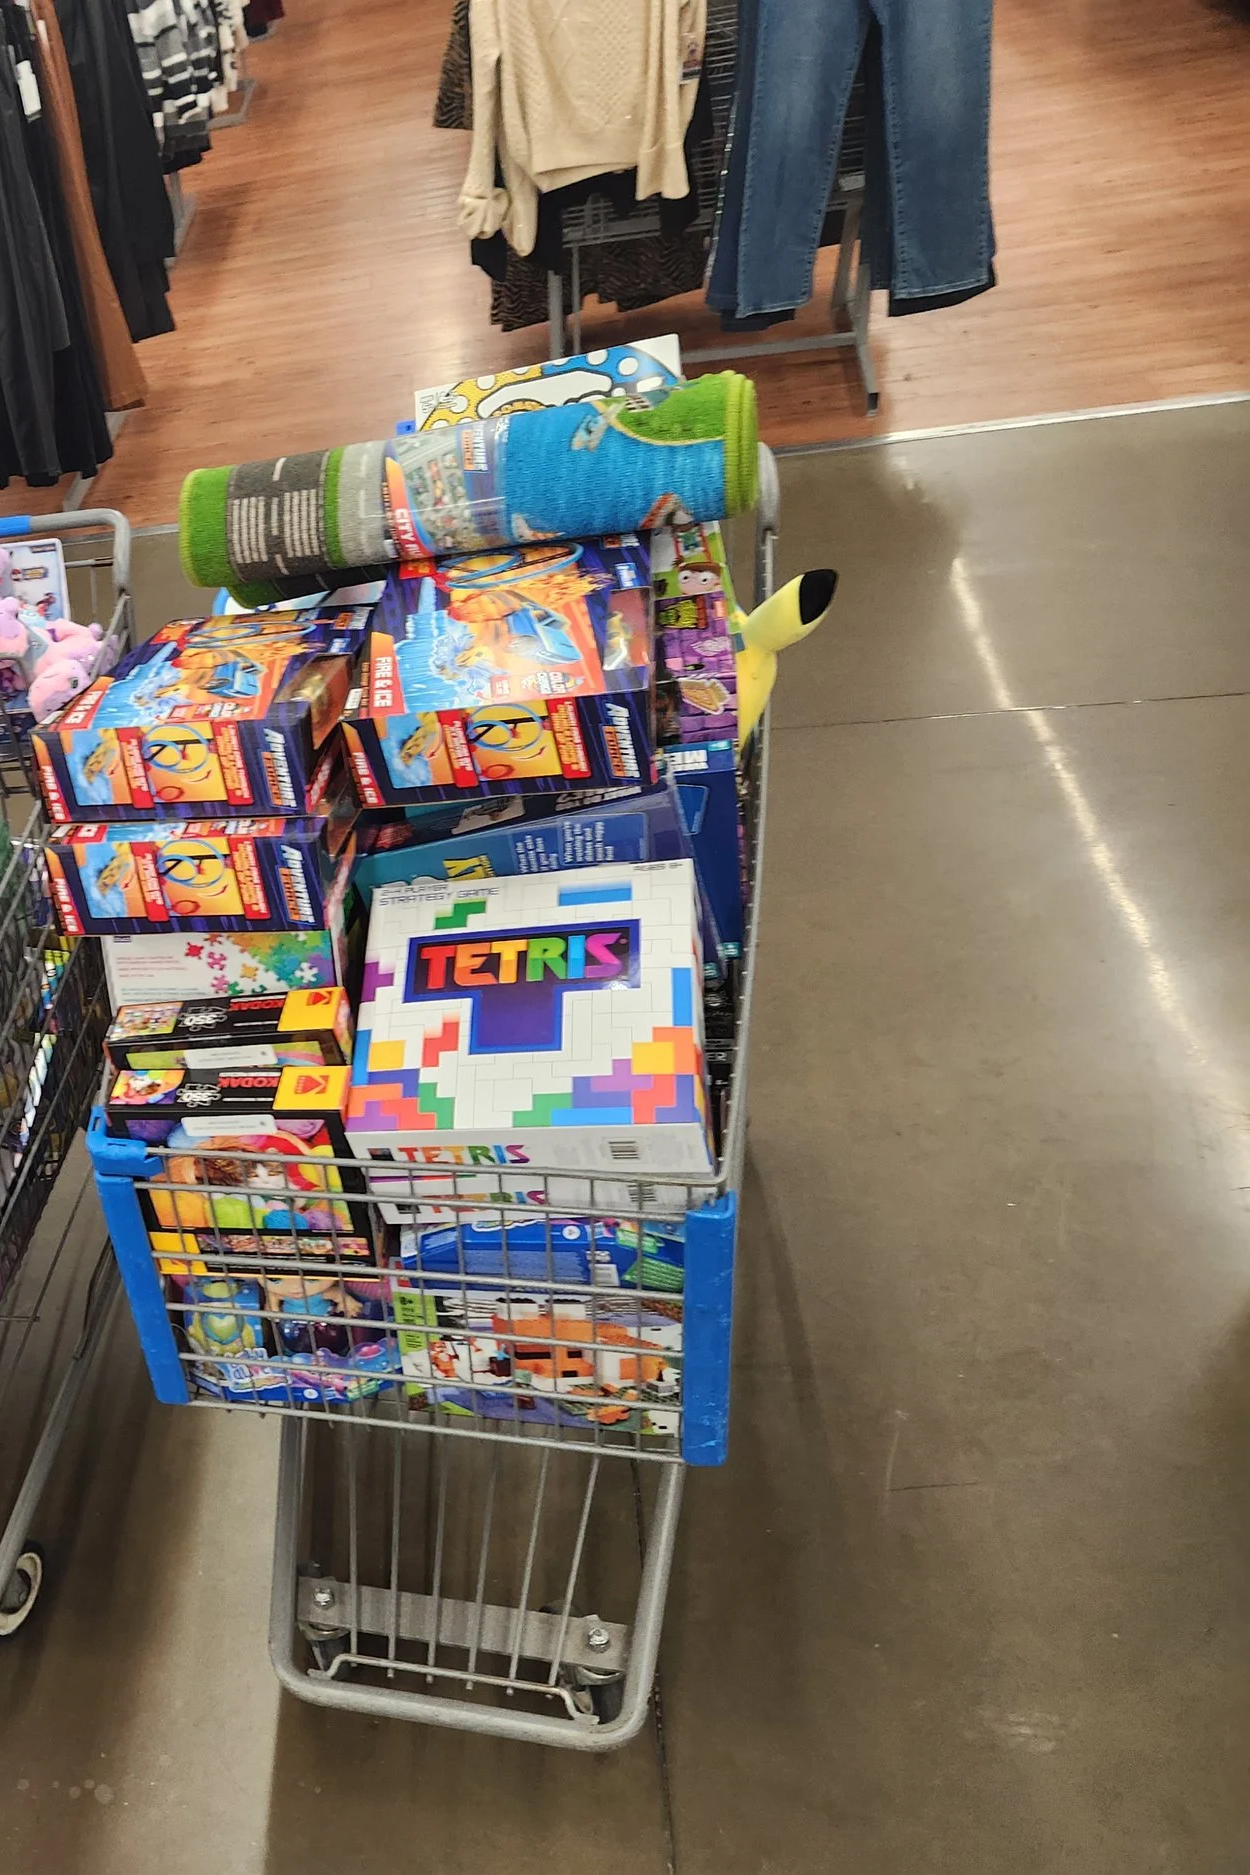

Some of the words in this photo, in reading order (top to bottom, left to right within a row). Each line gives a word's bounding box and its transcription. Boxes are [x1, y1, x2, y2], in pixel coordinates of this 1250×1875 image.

[394, 508, 417, 542] CITY
[375, 656, 392, 678] FIRE
[374, 679, 390, 689] &
[373, 690, 392, 708] ICE
[606, 702, 640, 779] ADVENTURE
[263, 728, 298, 808] ADVENTURE
[352, 752, 369, 775] FIRE
[364, 787, 379, 804] ICE
[282, 844, 316, 924] ADVENTURE
[379, 890, 455, 907] STRATEGY
[457, 886, 500, 900] GAME
[420, 932, 624, 990] TETRIS
[228, 998, 287, 1012] KODAK
[184, 1014, 213, 1027] 350
[218, 1076, 281, 1089] KODAK
[184, 1091, 214, 1102] 350
[397, 1144, 531, 1165] TETRIS
